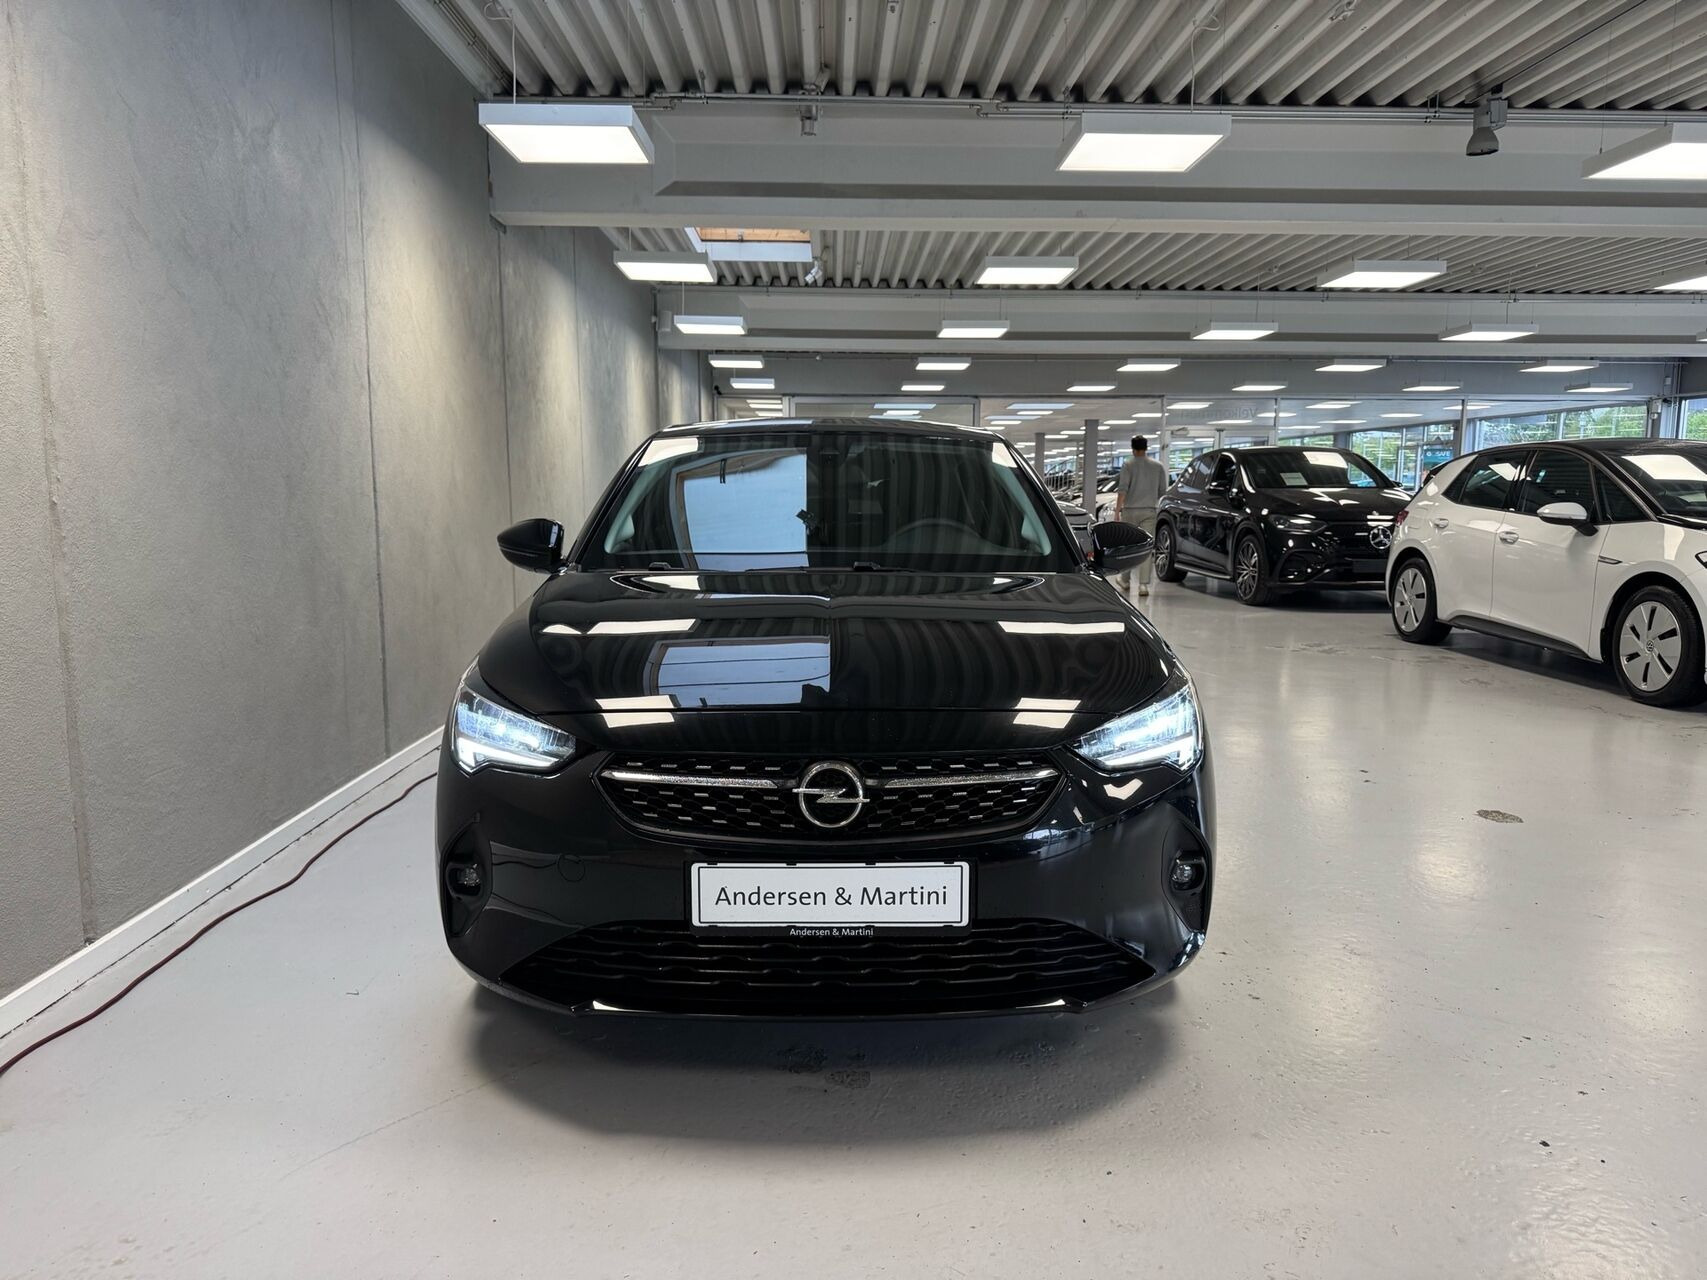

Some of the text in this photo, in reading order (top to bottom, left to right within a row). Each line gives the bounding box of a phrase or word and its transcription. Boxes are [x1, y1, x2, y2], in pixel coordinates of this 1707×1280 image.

[715, 885, 948, 906] Andersen & Martini
[789, 927, 874, 936] Andersen & Martini
